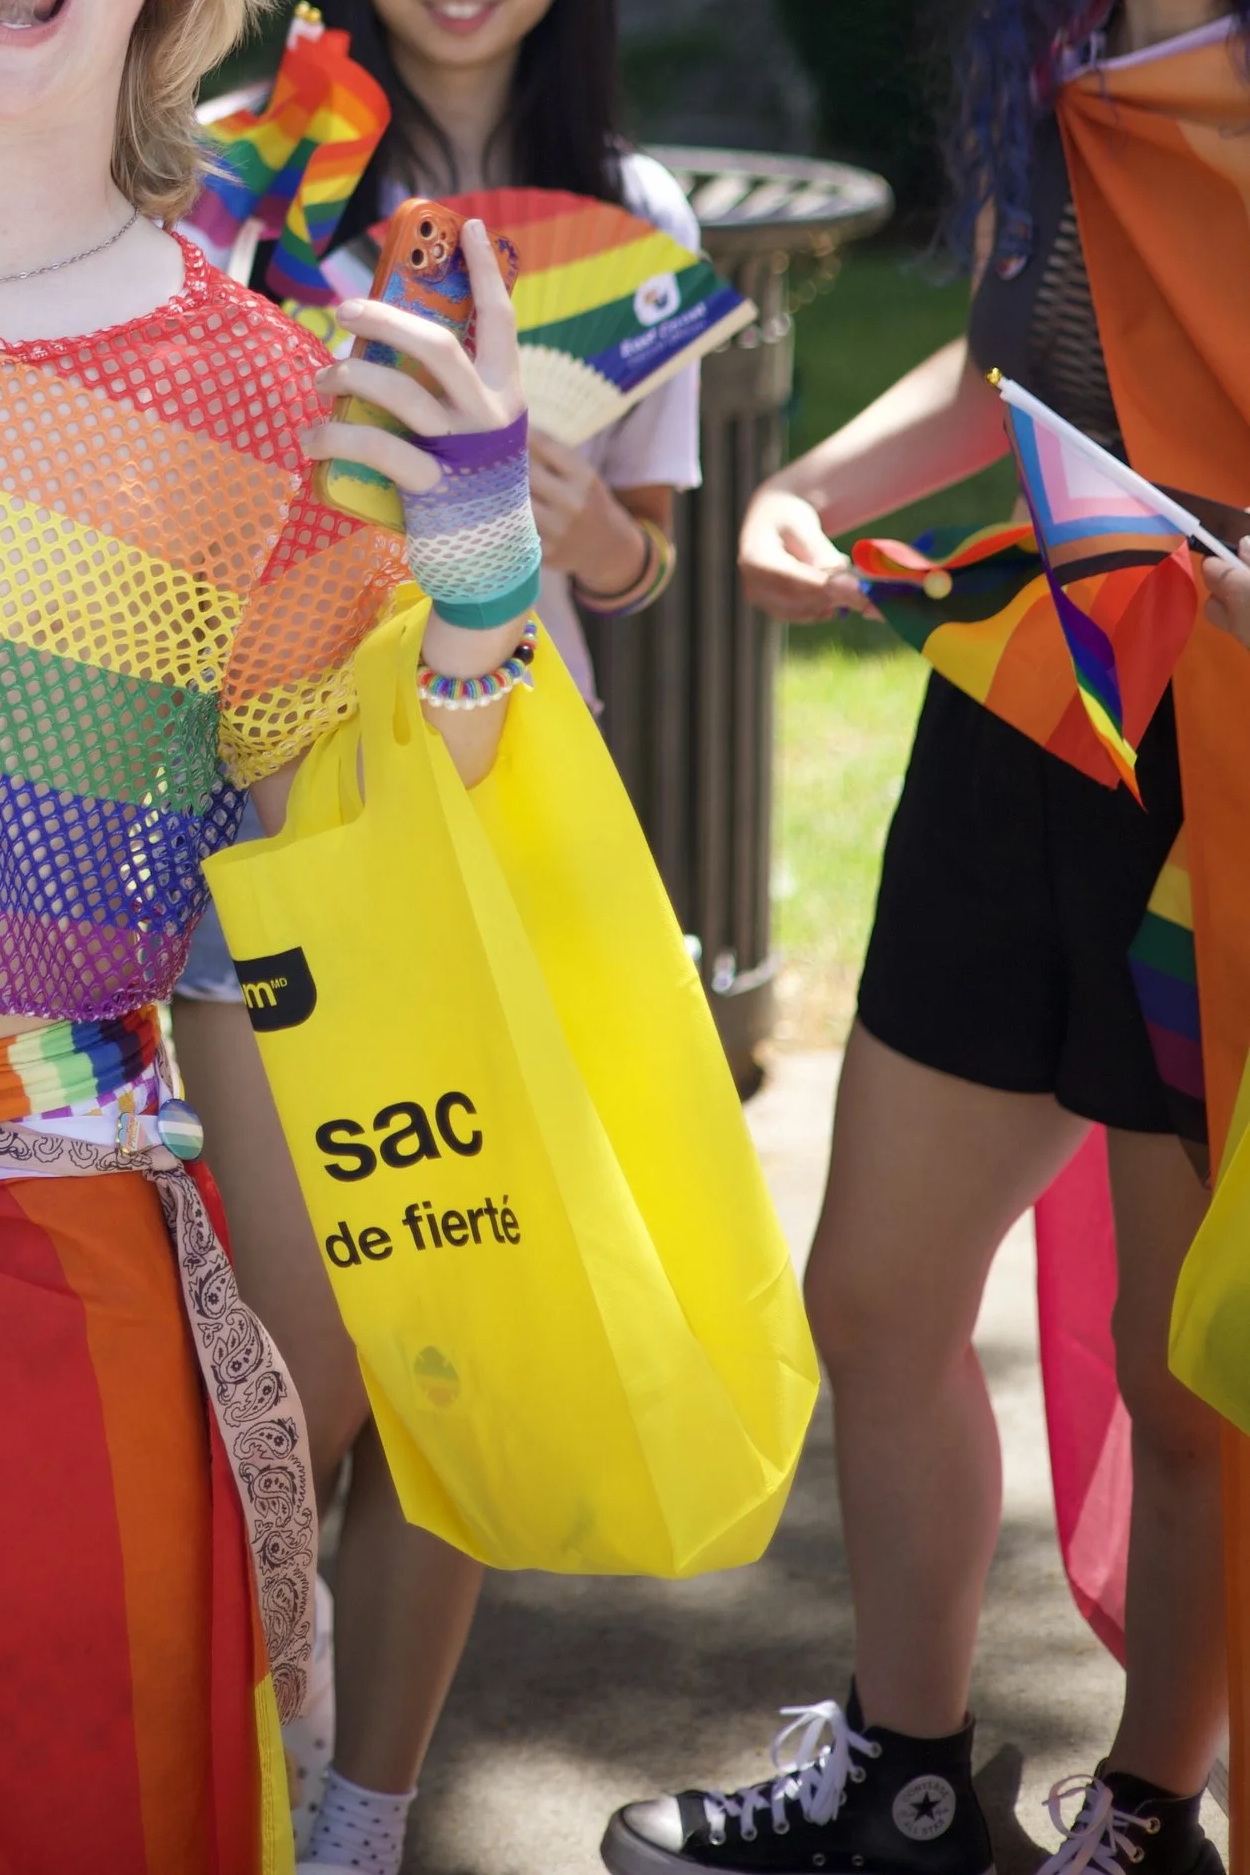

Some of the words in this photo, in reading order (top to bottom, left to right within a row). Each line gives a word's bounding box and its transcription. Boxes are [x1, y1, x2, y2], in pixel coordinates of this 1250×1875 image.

[315, 1091, 483, 1183] sac
[325, 1221, 393, 1268] de
[402, 1194, 521, 1251] fierté
